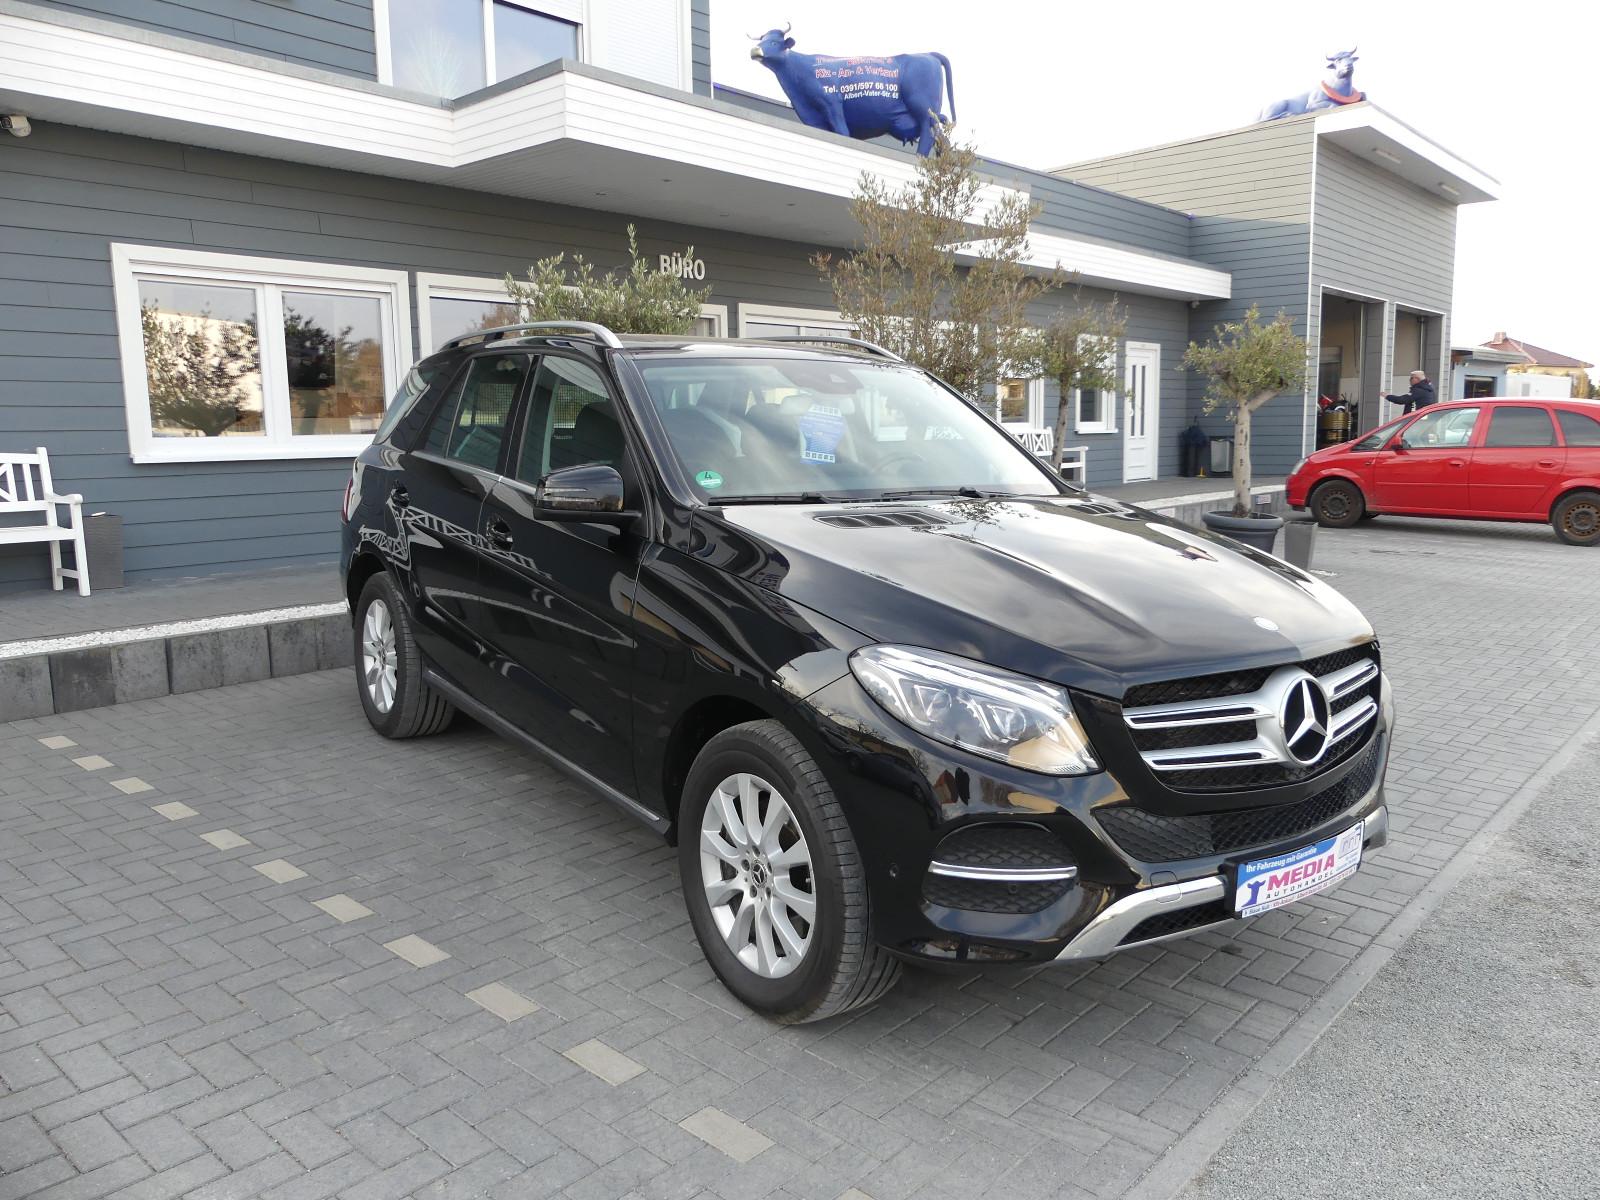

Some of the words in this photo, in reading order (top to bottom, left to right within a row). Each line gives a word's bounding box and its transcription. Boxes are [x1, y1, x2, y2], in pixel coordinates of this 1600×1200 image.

[823, 85, 838, 93] Tel.
[886, 83, 898, 92] 100
[659, 251, 706, 280] BÜRO
[704, 471, 713, 480] 4
[1246, 863, 1256, 873] Ihr
[1257, 857, 1286, 871] Fahrzeug
[1286, 856, 1297, 865] mit
[1267, 853, 1335, 891] MEDIA
[1266, 870, 1334, 899] AUTOHANDEL
